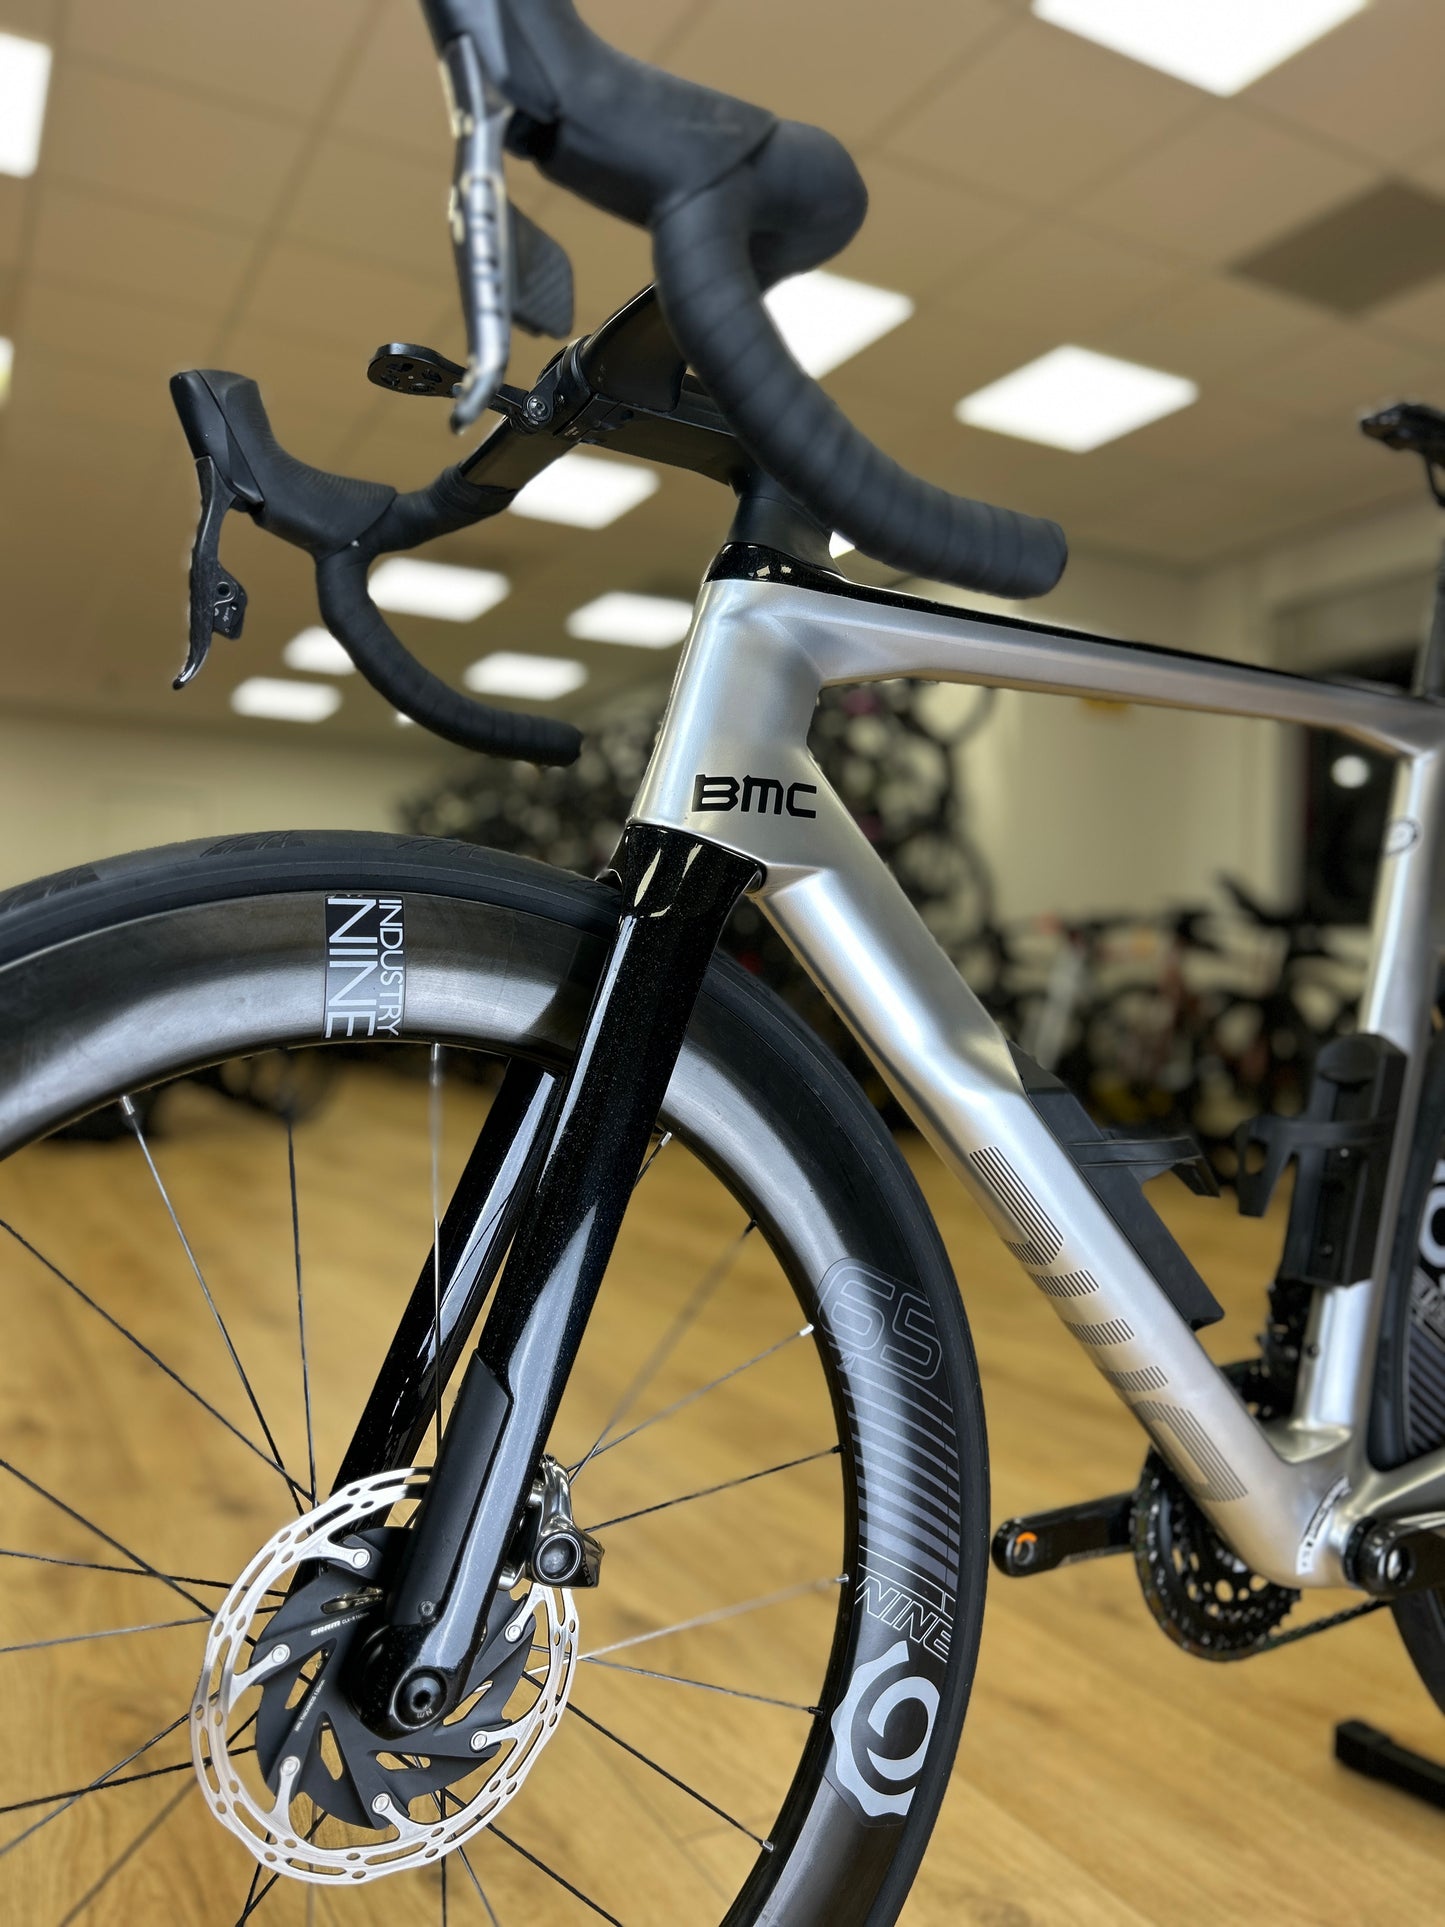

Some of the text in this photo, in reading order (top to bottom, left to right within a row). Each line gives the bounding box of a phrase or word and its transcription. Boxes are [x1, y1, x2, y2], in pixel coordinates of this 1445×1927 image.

[691, 774, 817, 819] BMC
[325, 898, 378, 1038] NINE
[376, 899, 404, 1036] INDUSTRY
[817, 1265, 942, 1380] 65
[310, 1620, 341, 1637] SRAM
[854, 1575, 953, 1663] NINE
